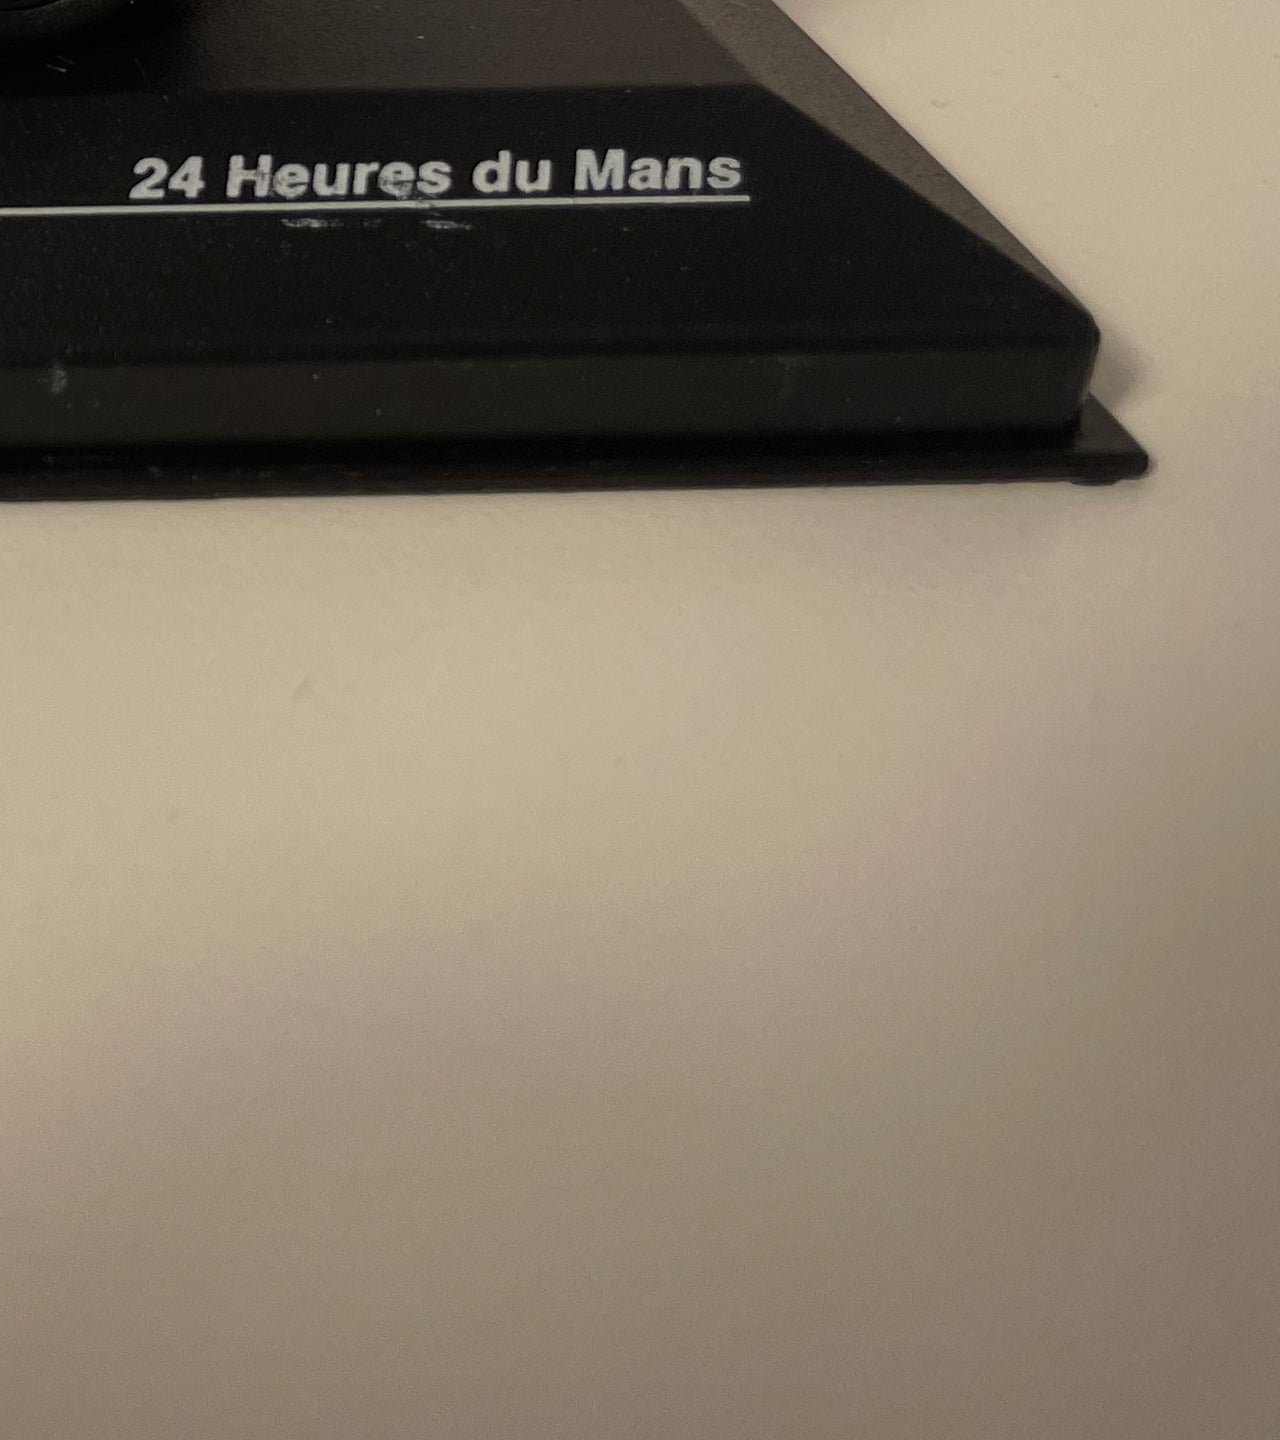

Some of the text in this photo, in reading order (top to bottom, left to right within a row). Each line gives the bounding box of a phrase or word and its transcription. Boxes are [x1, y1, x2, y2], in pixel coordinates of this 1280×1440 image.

[128, 148, 742, 200] 24 Heures du Mans
